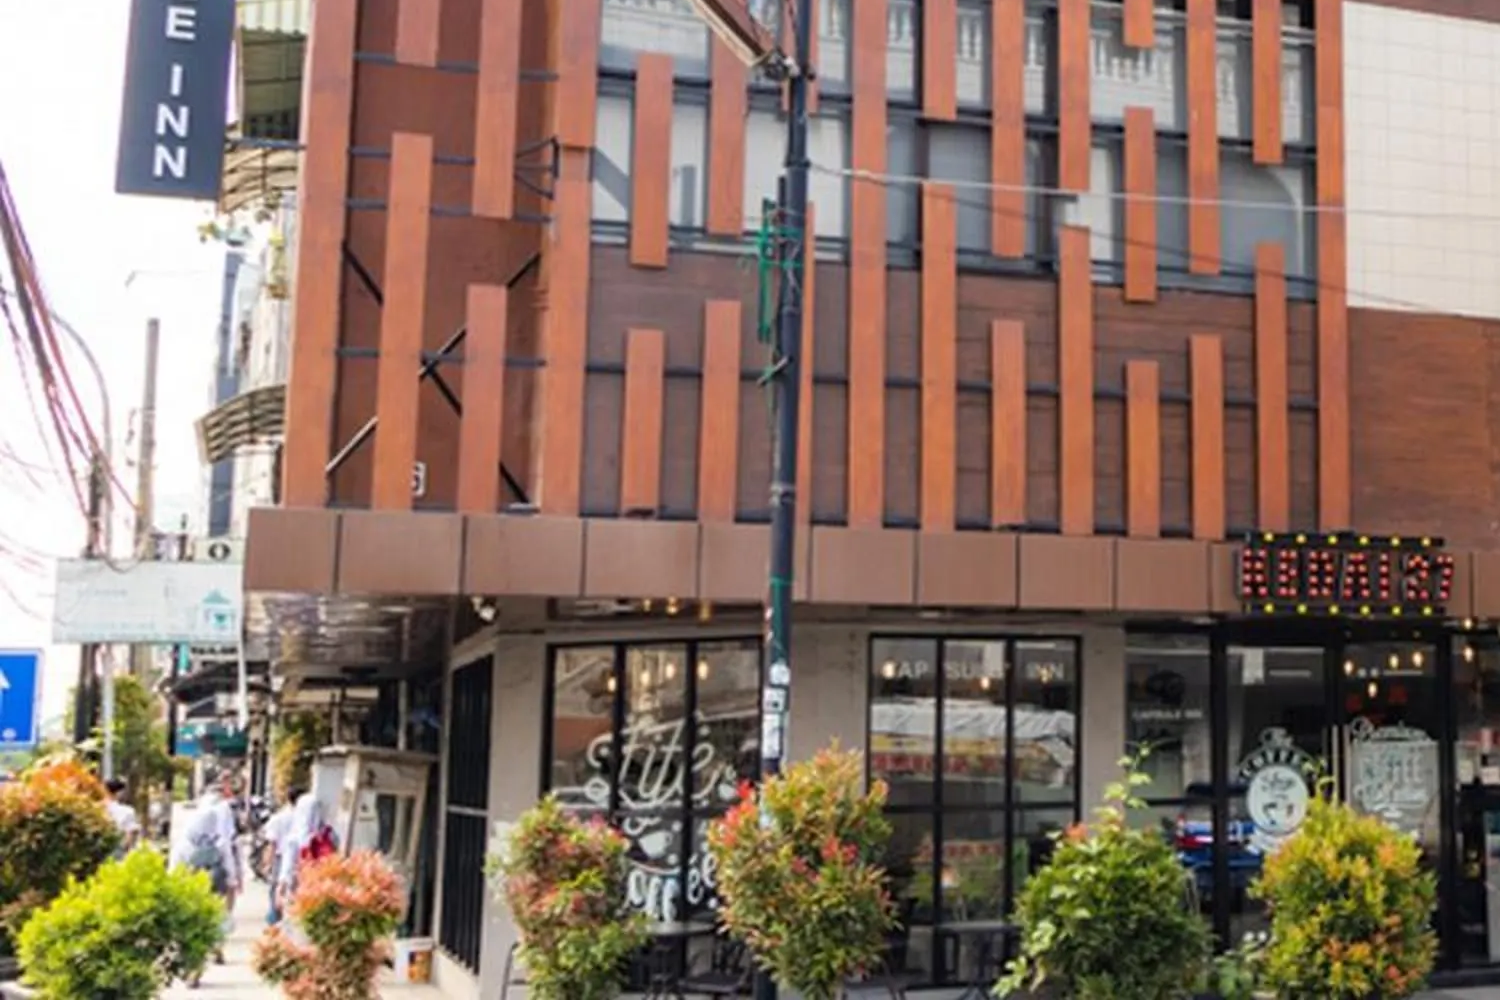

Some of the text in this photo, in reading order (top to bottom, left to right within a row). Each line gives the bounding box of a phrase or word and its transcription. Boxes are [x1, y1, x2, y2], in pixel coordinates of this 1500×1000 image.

[153, 63, 190, 179] INN
[1242, 548, 1455, 601] KEDAI 27
